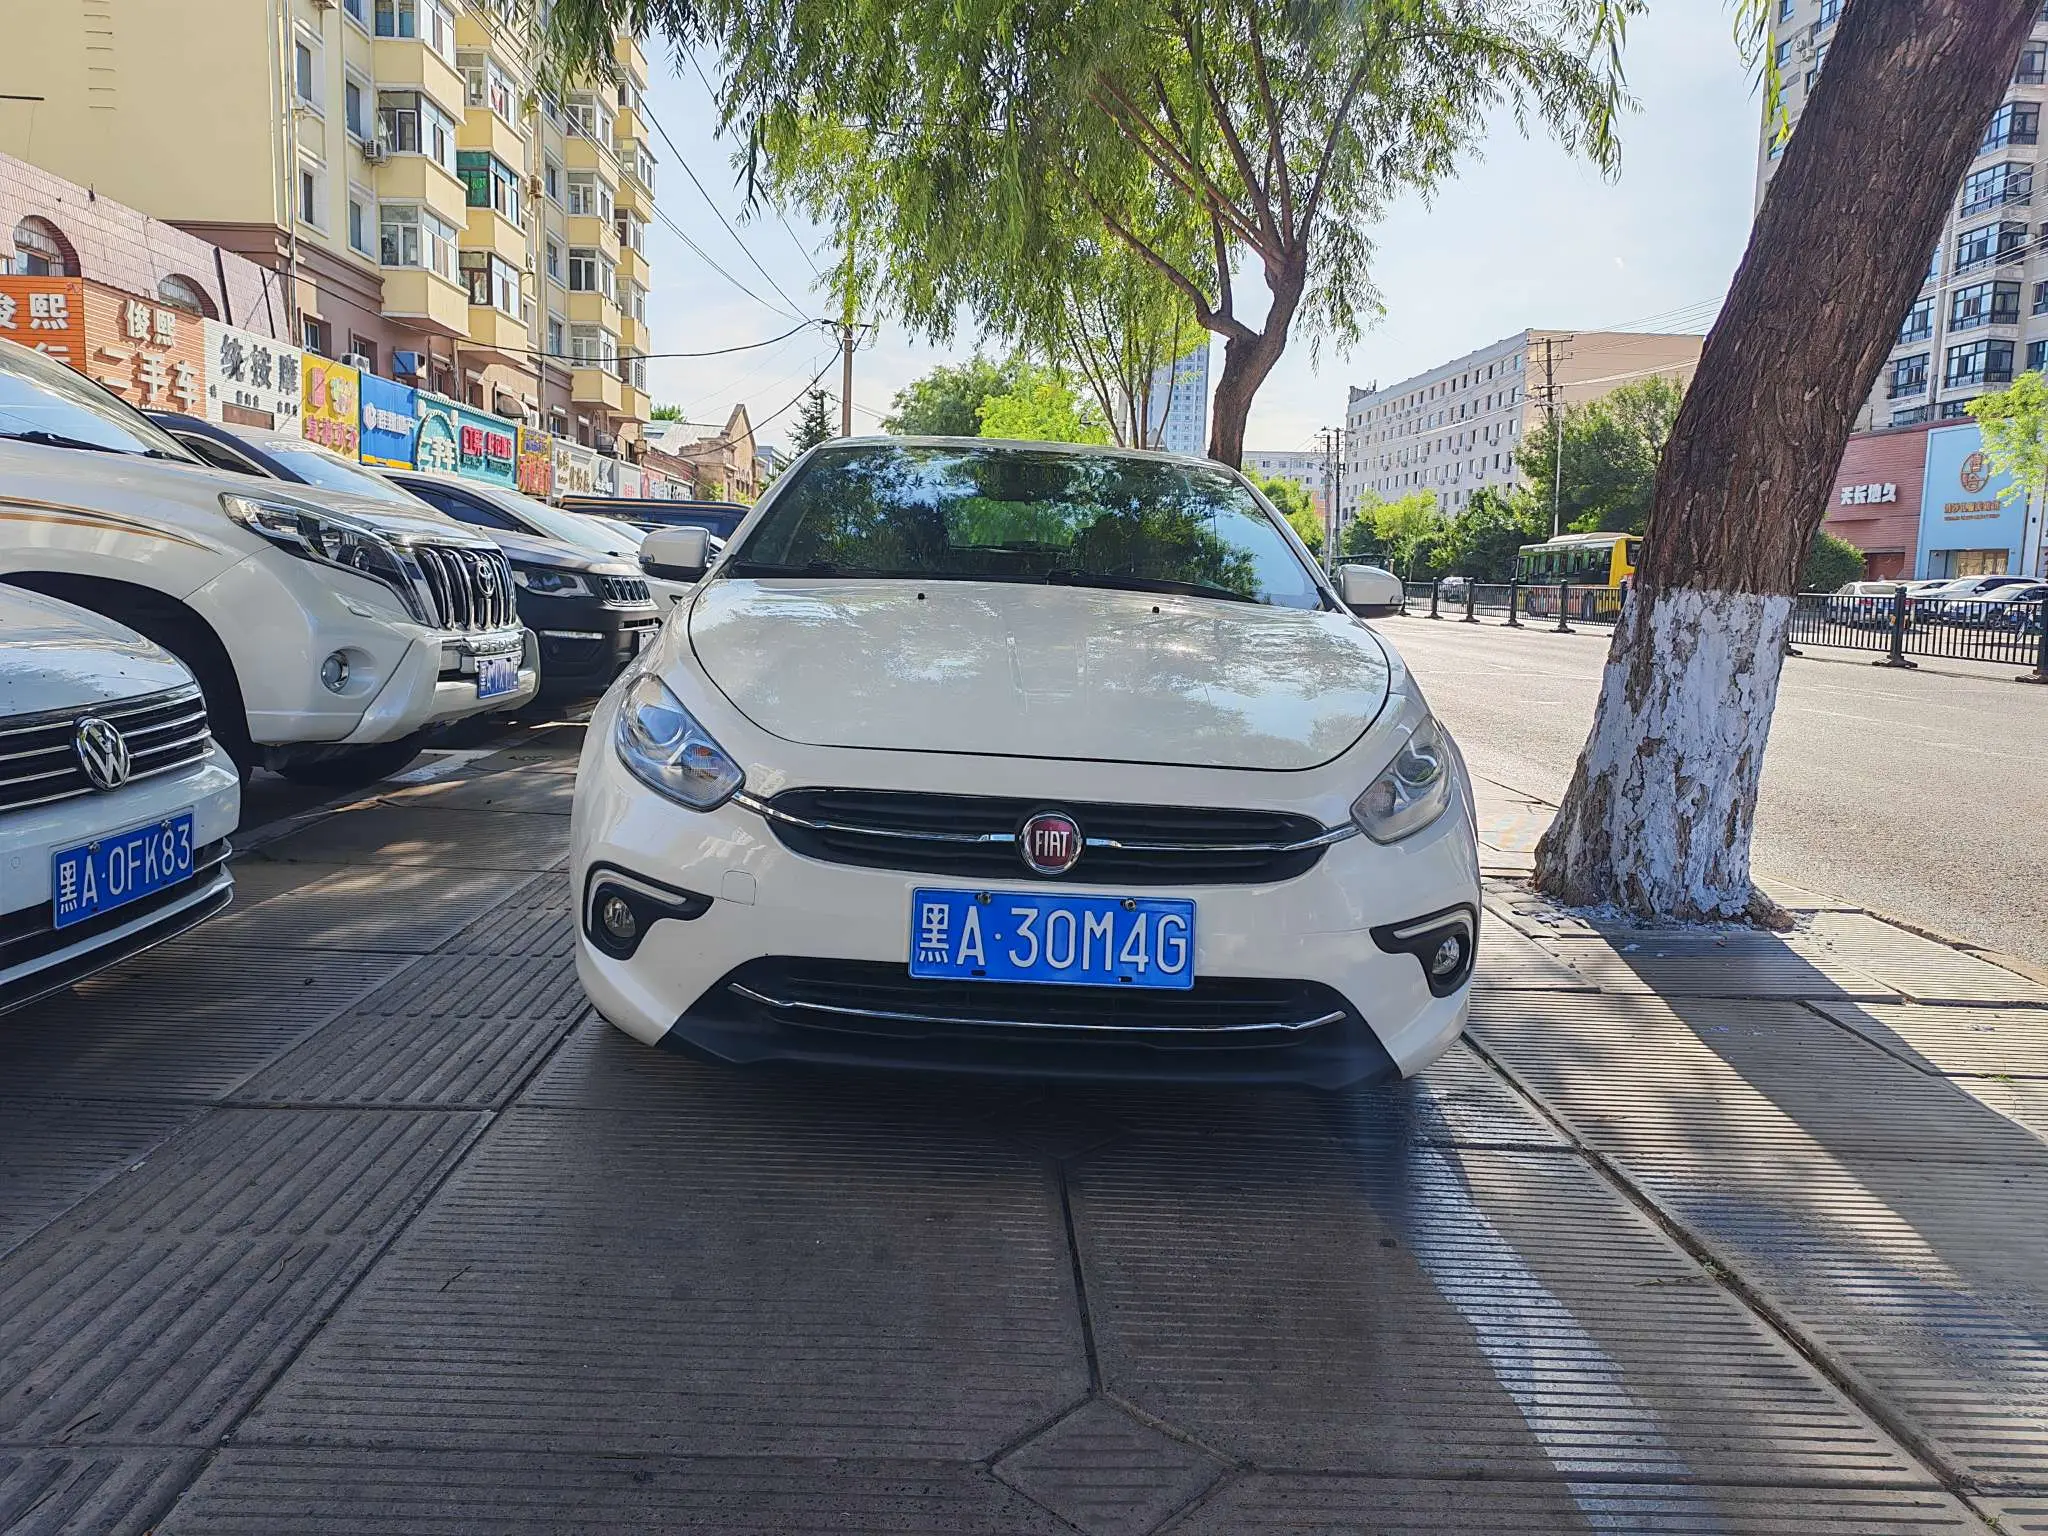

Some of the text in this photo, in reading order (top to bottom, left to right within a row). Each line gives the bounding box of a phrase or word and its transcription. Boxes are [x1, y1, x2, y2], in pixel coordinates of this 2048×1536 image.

[125, 299, 176, 346] 俊熙
[101, 345, 199, 408] 二手车
[1035, 830, 1069, 857] FIAT
